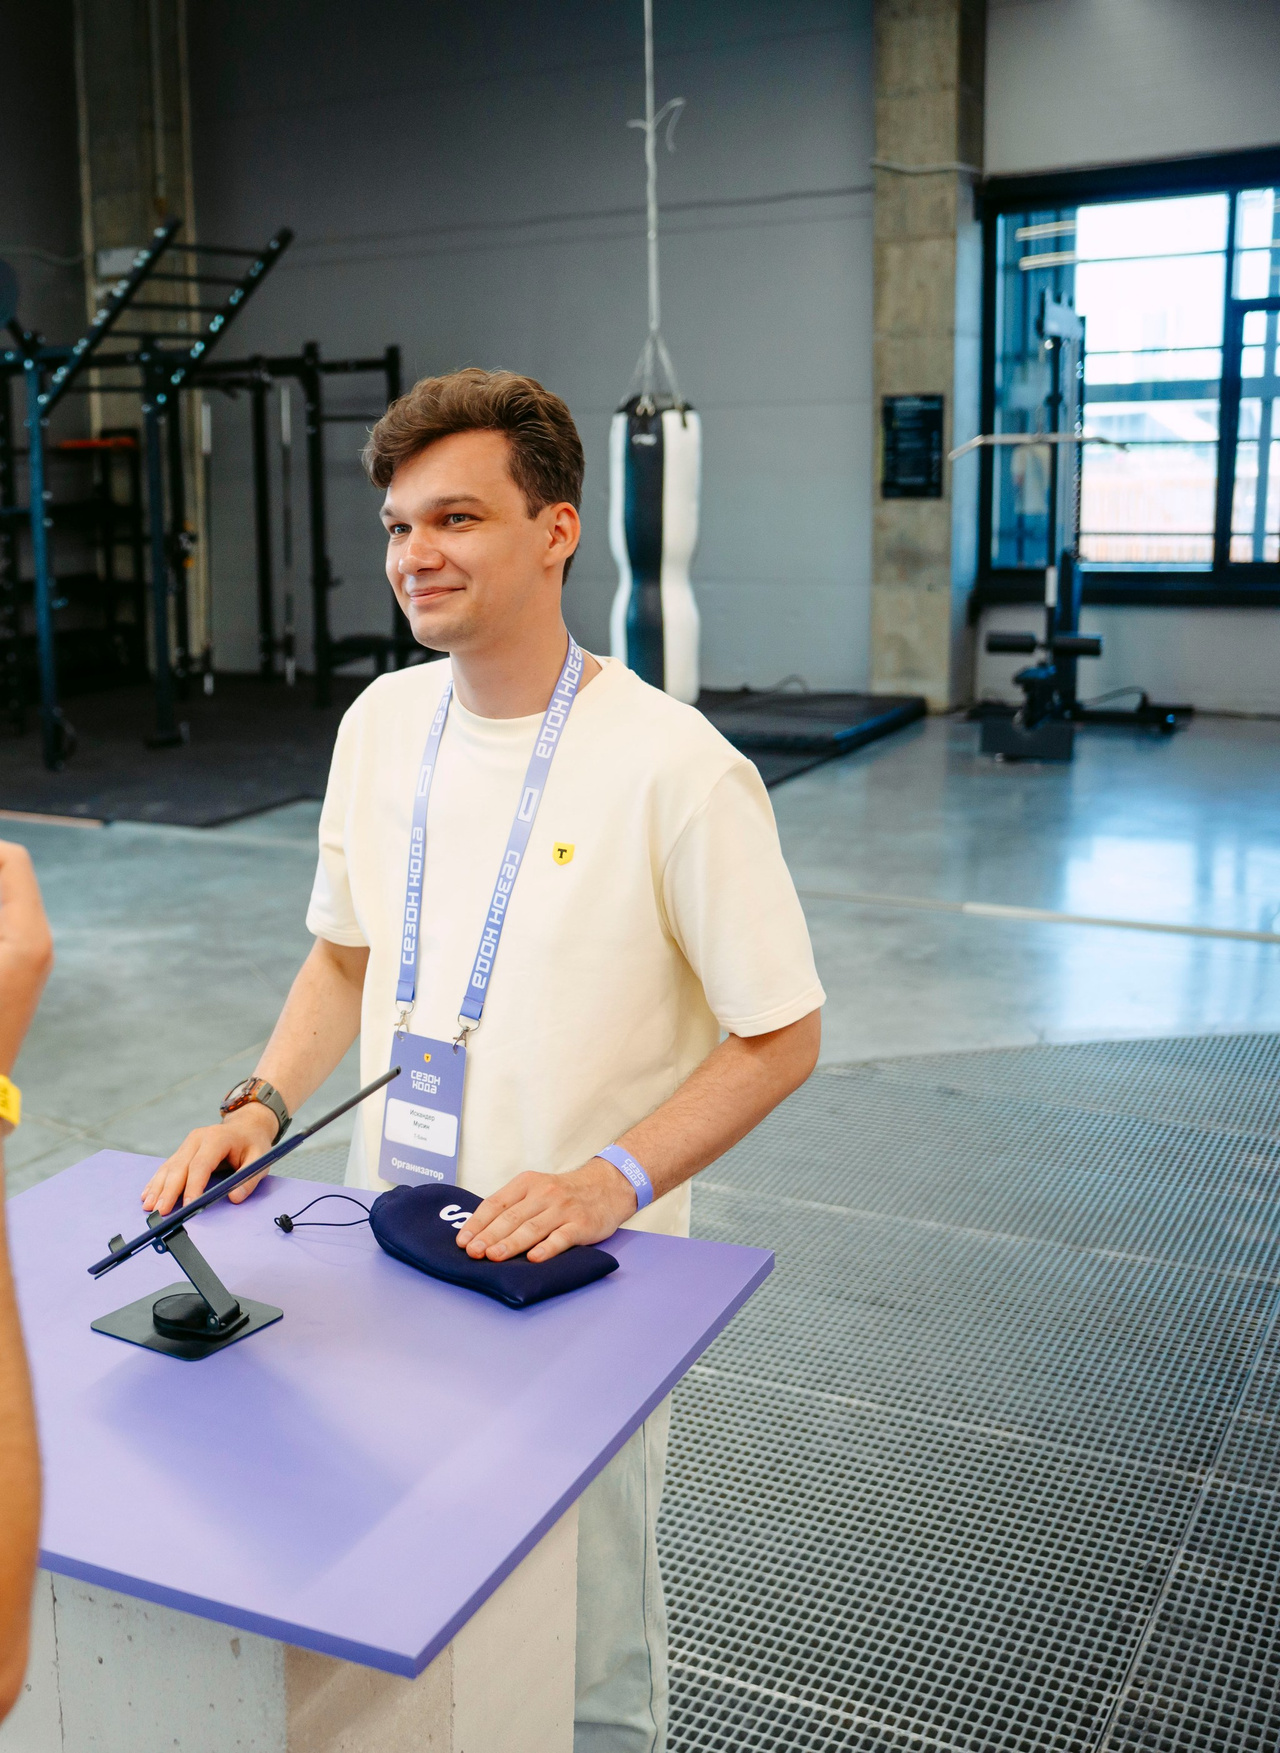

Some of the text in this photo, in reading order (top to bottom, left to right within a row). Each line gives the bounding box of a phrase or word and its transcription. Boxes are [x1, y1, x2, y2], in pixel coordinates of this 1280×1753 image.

[535, 697, 570, 759] кода
[402, 826, 423, 965] сезон кода
[471, 850, 521, 990] сезон кода
[410, 1069, 441, 1086] сезон
[411, 1080, 438, 1095] кода
[391, 1157, 445, 1181] Организатор
[620, 1163, 641, 1188] кода
[624, 1158, 648, 1186] сезон
